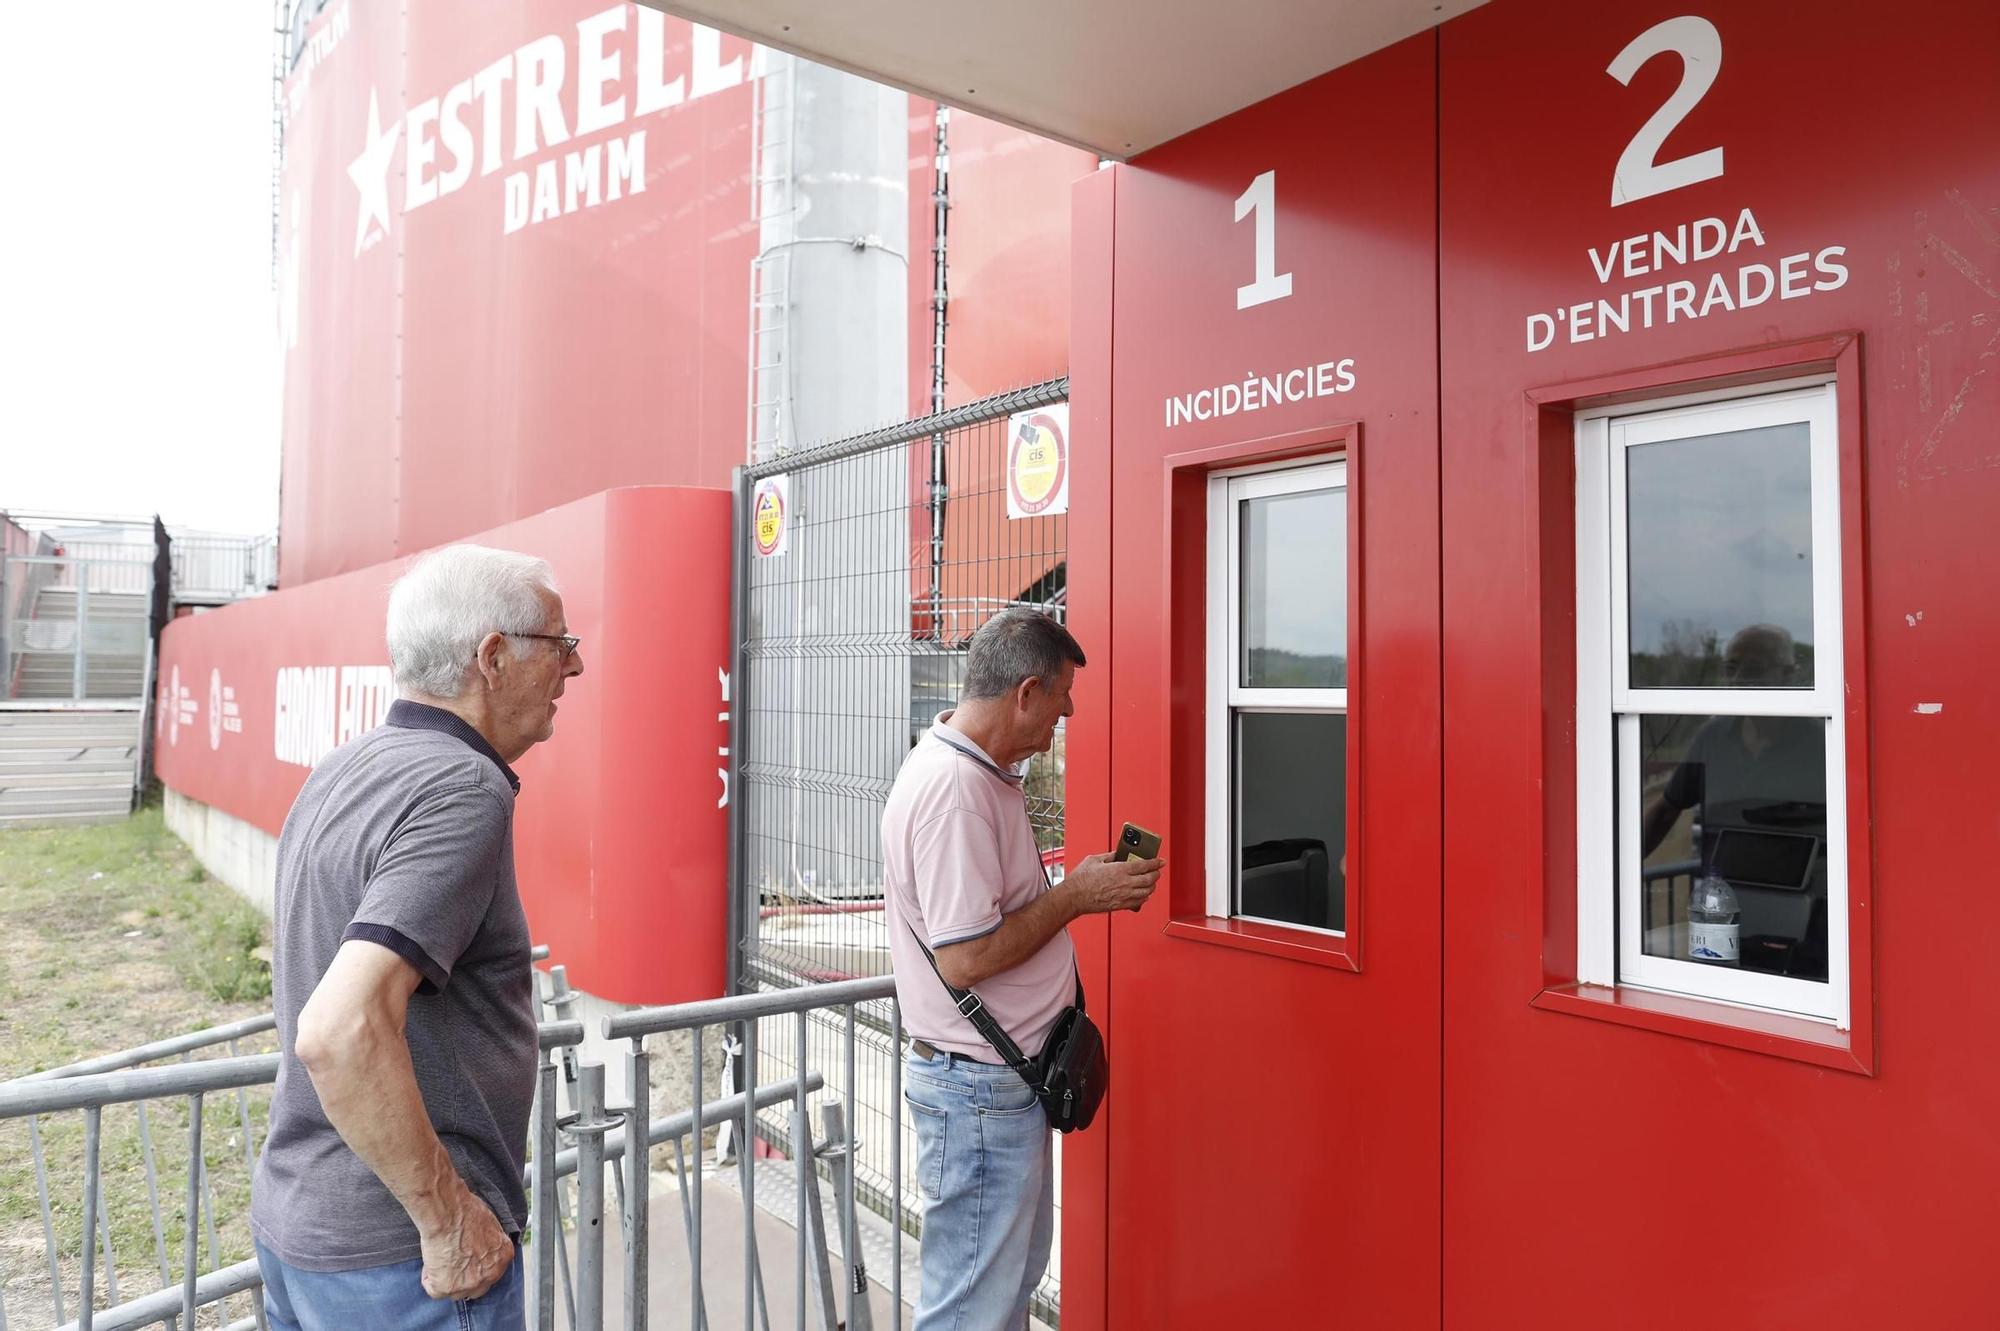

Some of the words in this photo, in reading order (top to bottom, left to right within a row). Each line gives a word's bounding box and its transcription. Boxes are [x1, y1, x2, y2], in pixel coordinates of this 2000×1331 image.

[1606, 16, 1724, 207] 2
[504, 131, 646, 235] DAMM
[1234, 170, 1293, 311] 1
[1588, 207, 1766, 284] VENDA
[1526, 245, 1849, 353] D'ENTRADES
[1163, 359, 1356, 428] INCIDÈNCIES
[275, 665, 336, 768] GIRONA
